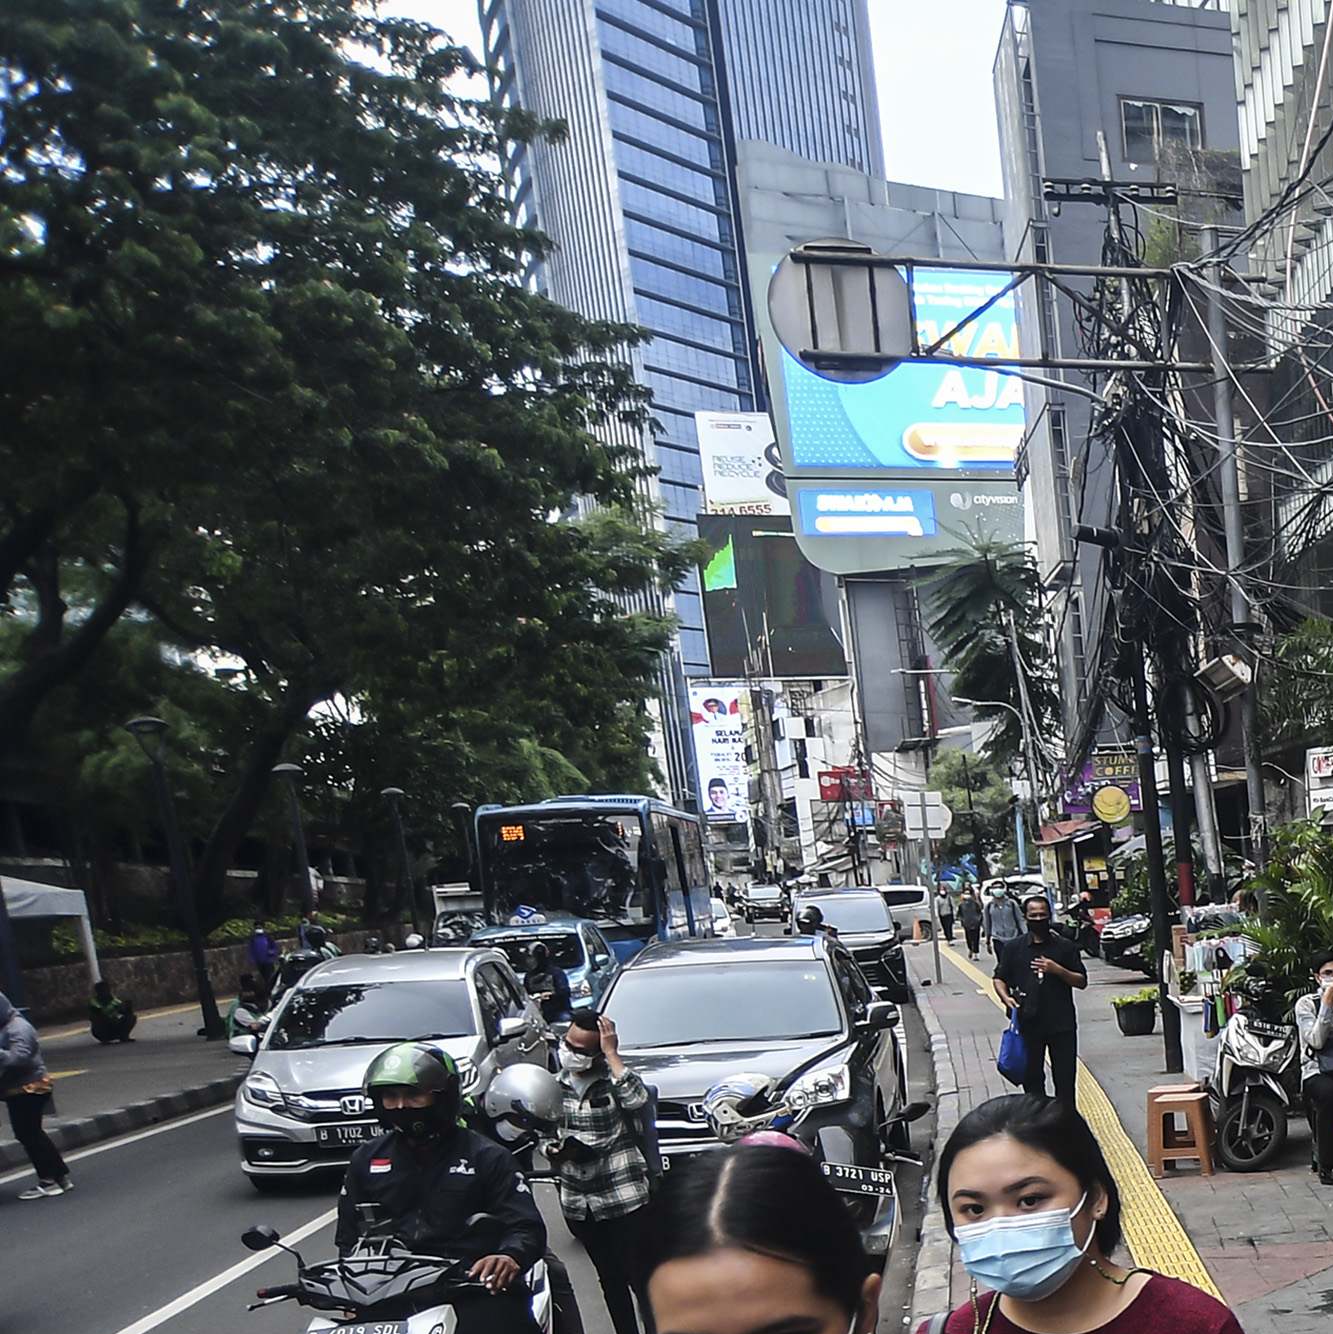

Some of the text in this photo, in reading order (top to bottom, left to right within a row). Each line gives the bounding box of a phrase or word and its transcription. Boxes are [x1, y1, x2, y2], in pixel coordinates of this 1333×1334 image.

[932, 370, 1025, 409] AJA
[713, 463, 753, 471] REDUCE
[714, 470, 760, 478] RECYCLE
[973, 494, 1018, 506] cityvision
[320, 1129, 328, 1140] B
[337, 1127, 363, 1140] 1702
[662, 1156, 670, 1171] B
[823, 1164, 891, 1183] B 3721 USP
